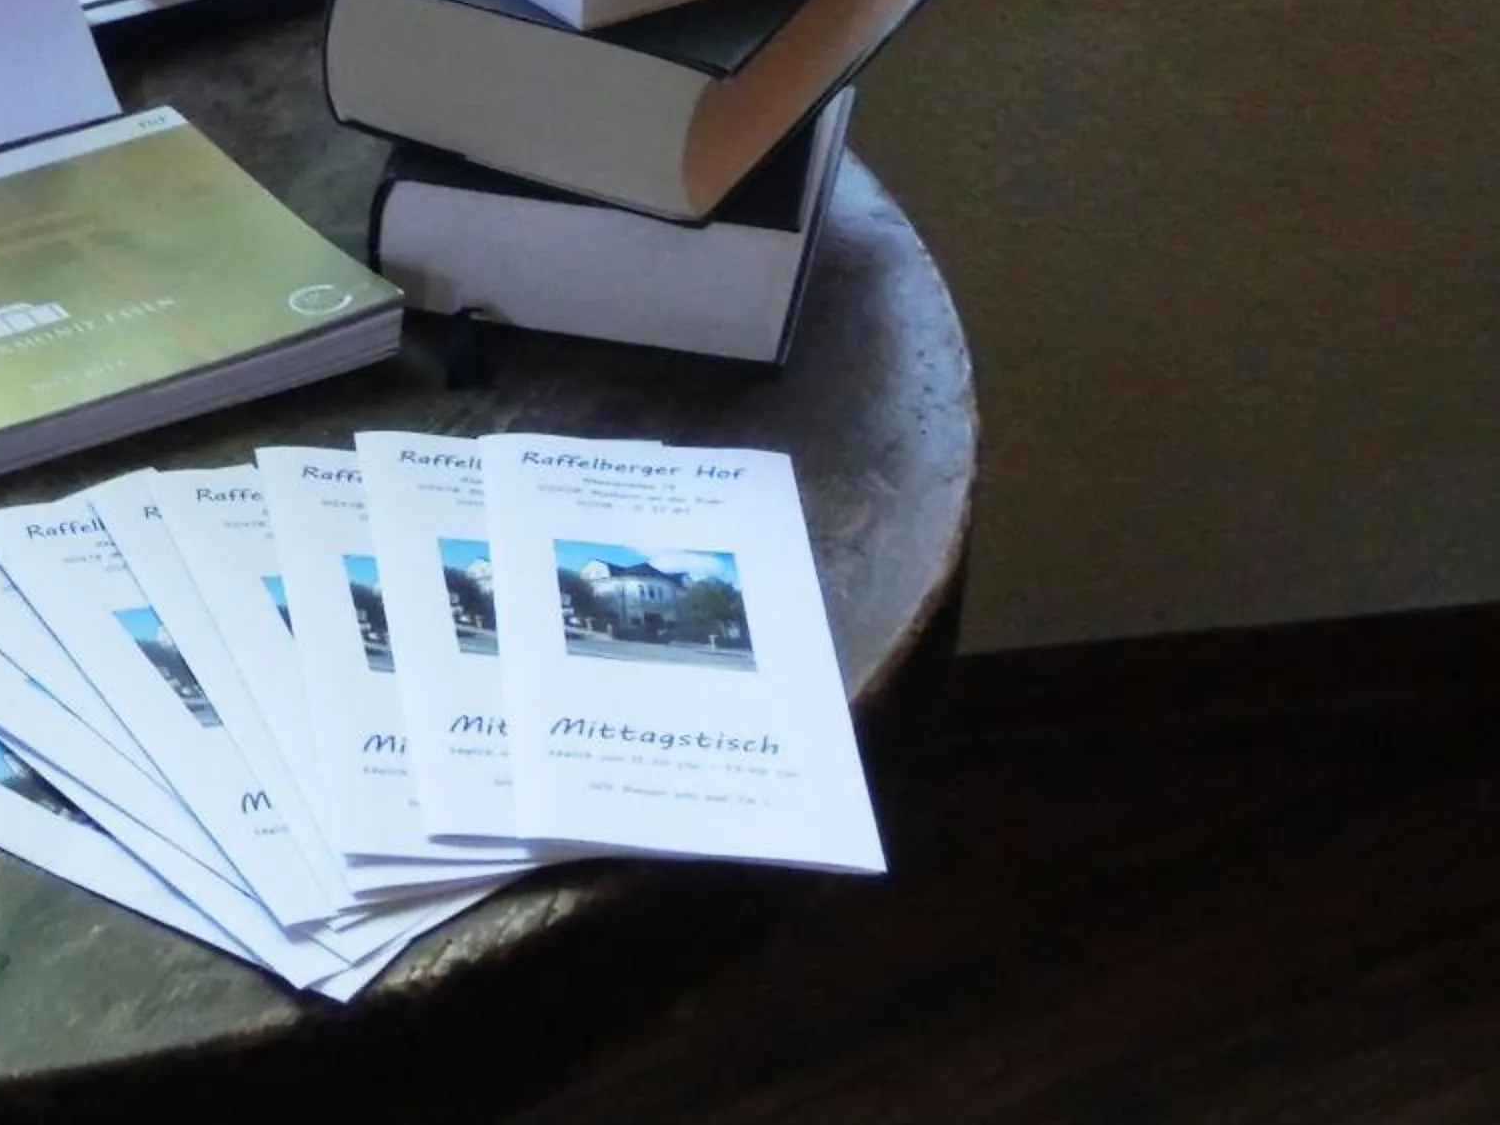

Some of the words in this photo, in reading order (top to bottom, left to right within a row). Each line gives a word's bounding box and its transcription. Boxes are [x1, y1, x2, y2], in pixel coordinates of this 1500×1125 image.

[521, 451, 682, 476] Raffelberger
[695, 465, 748, 480] Hof
[549, 716, 781, 756] Mittagstisch
